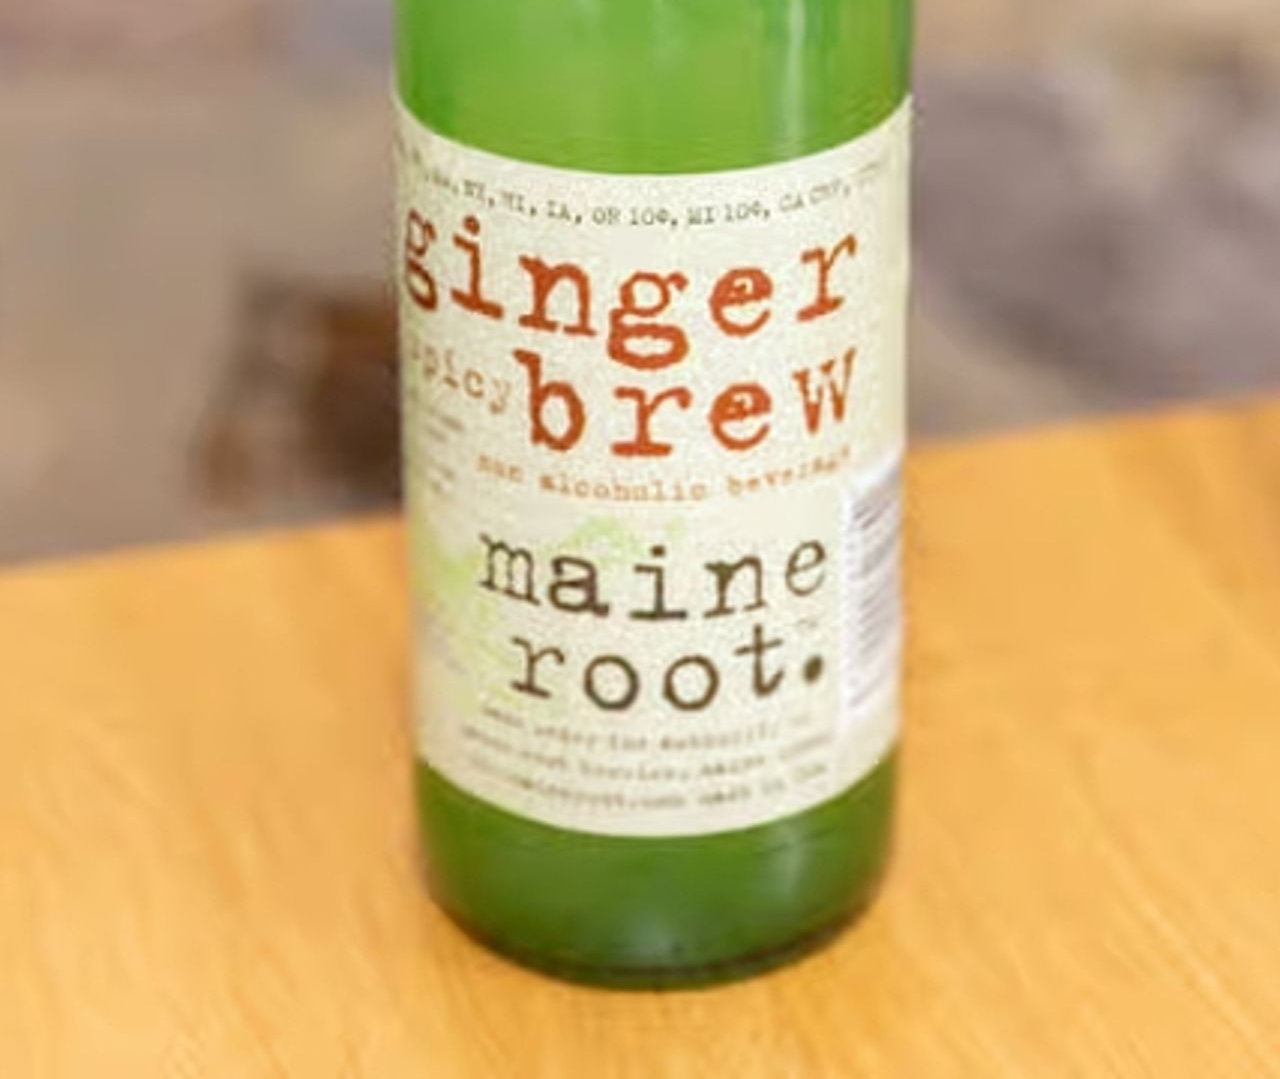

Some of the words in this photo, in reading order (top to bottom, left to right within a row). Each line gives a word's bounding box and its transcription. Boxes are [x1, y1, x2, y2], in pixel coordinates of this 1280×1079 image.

[405, 208, 857, 371] ginger
[513, 347, 857, 452] brew
[477, 532, 827, 620] maine
[510, 624, 825, 712] root.
